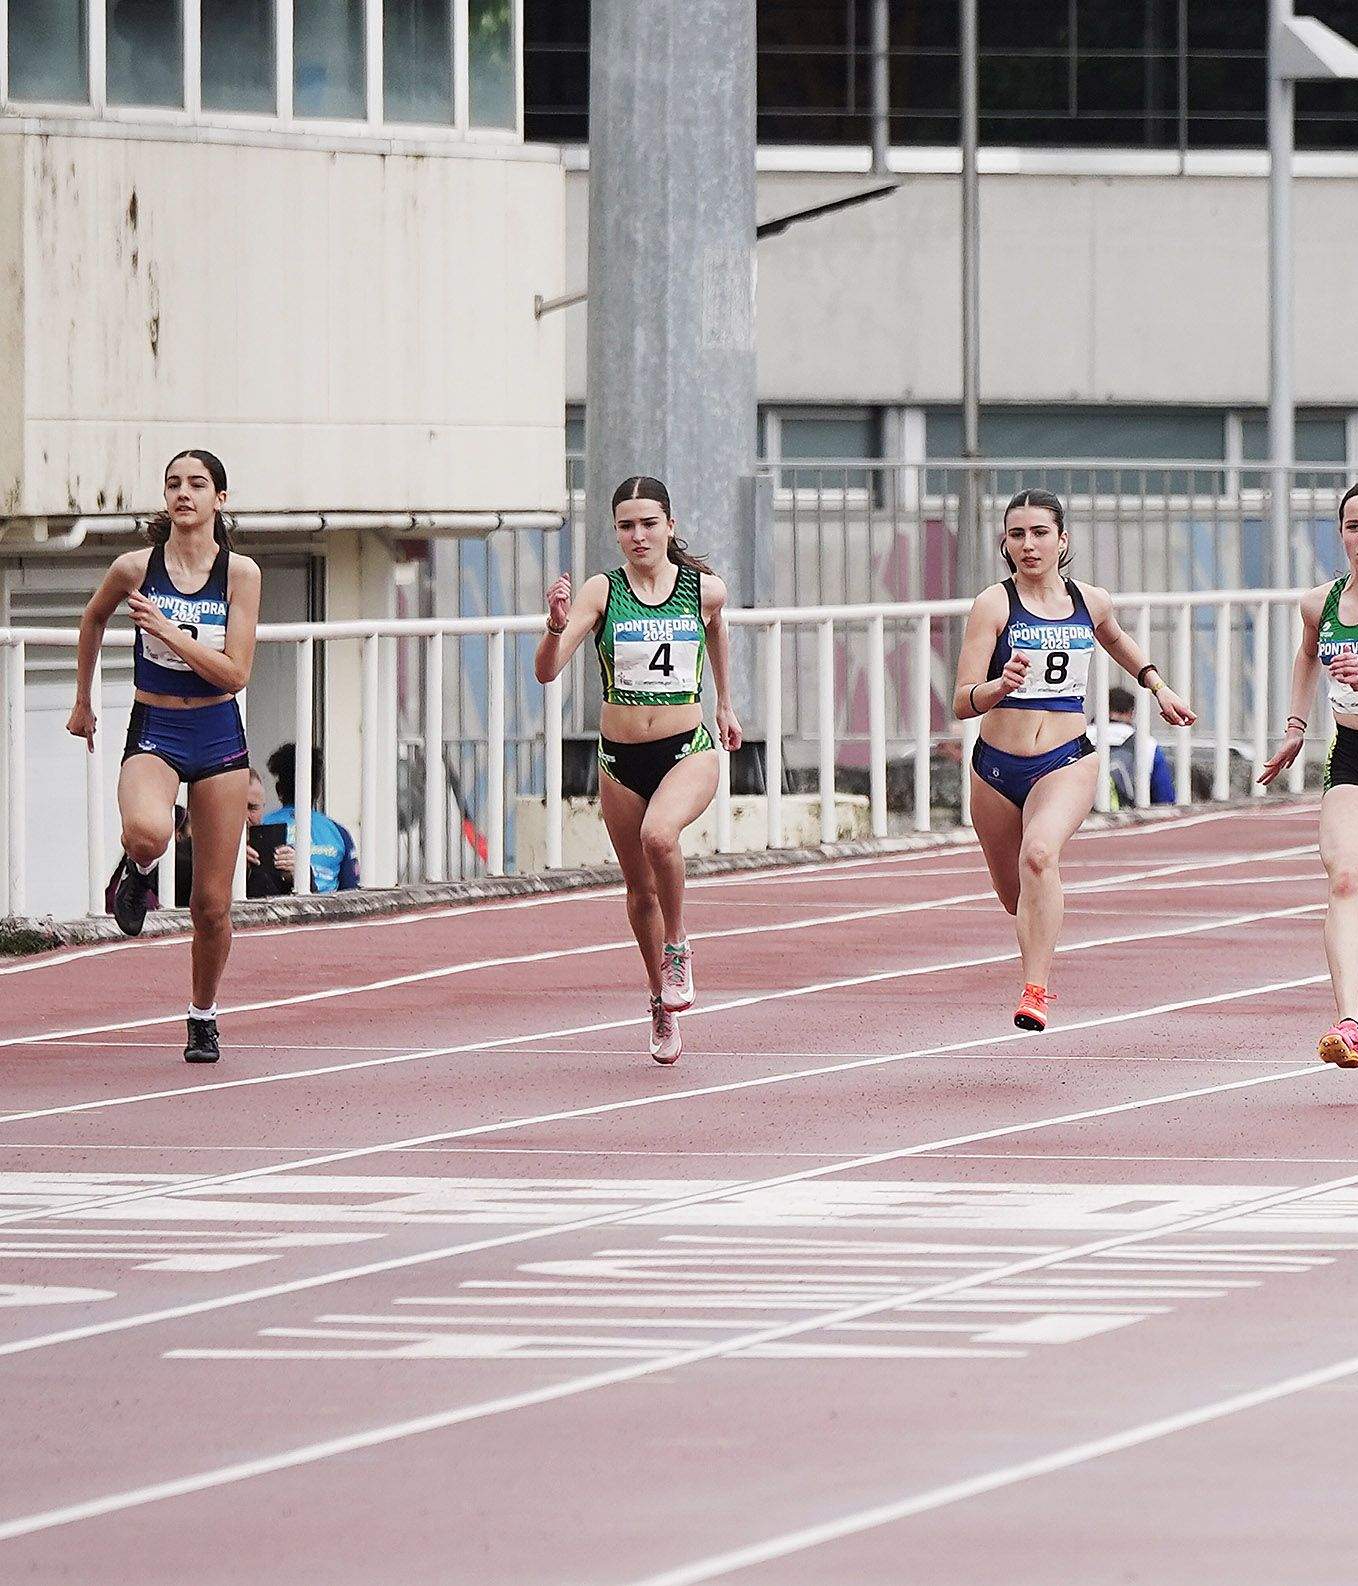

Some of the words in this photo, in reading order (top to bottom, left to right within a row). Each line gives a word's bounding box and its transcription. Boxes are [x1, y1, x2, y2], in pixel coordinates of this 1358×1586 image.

[171, 610, 200, 623] 2025
[616, 619, 698, 633] PONTEVEDRA
[643, 630, 674, 641] 2025
[1013, 626, 1093, 641] PONTEVEDRA
[1041, 638, 1070, 650] 2025
[648, 643, 674, 676] 4
[1044, 651, 1069, 684] 8
